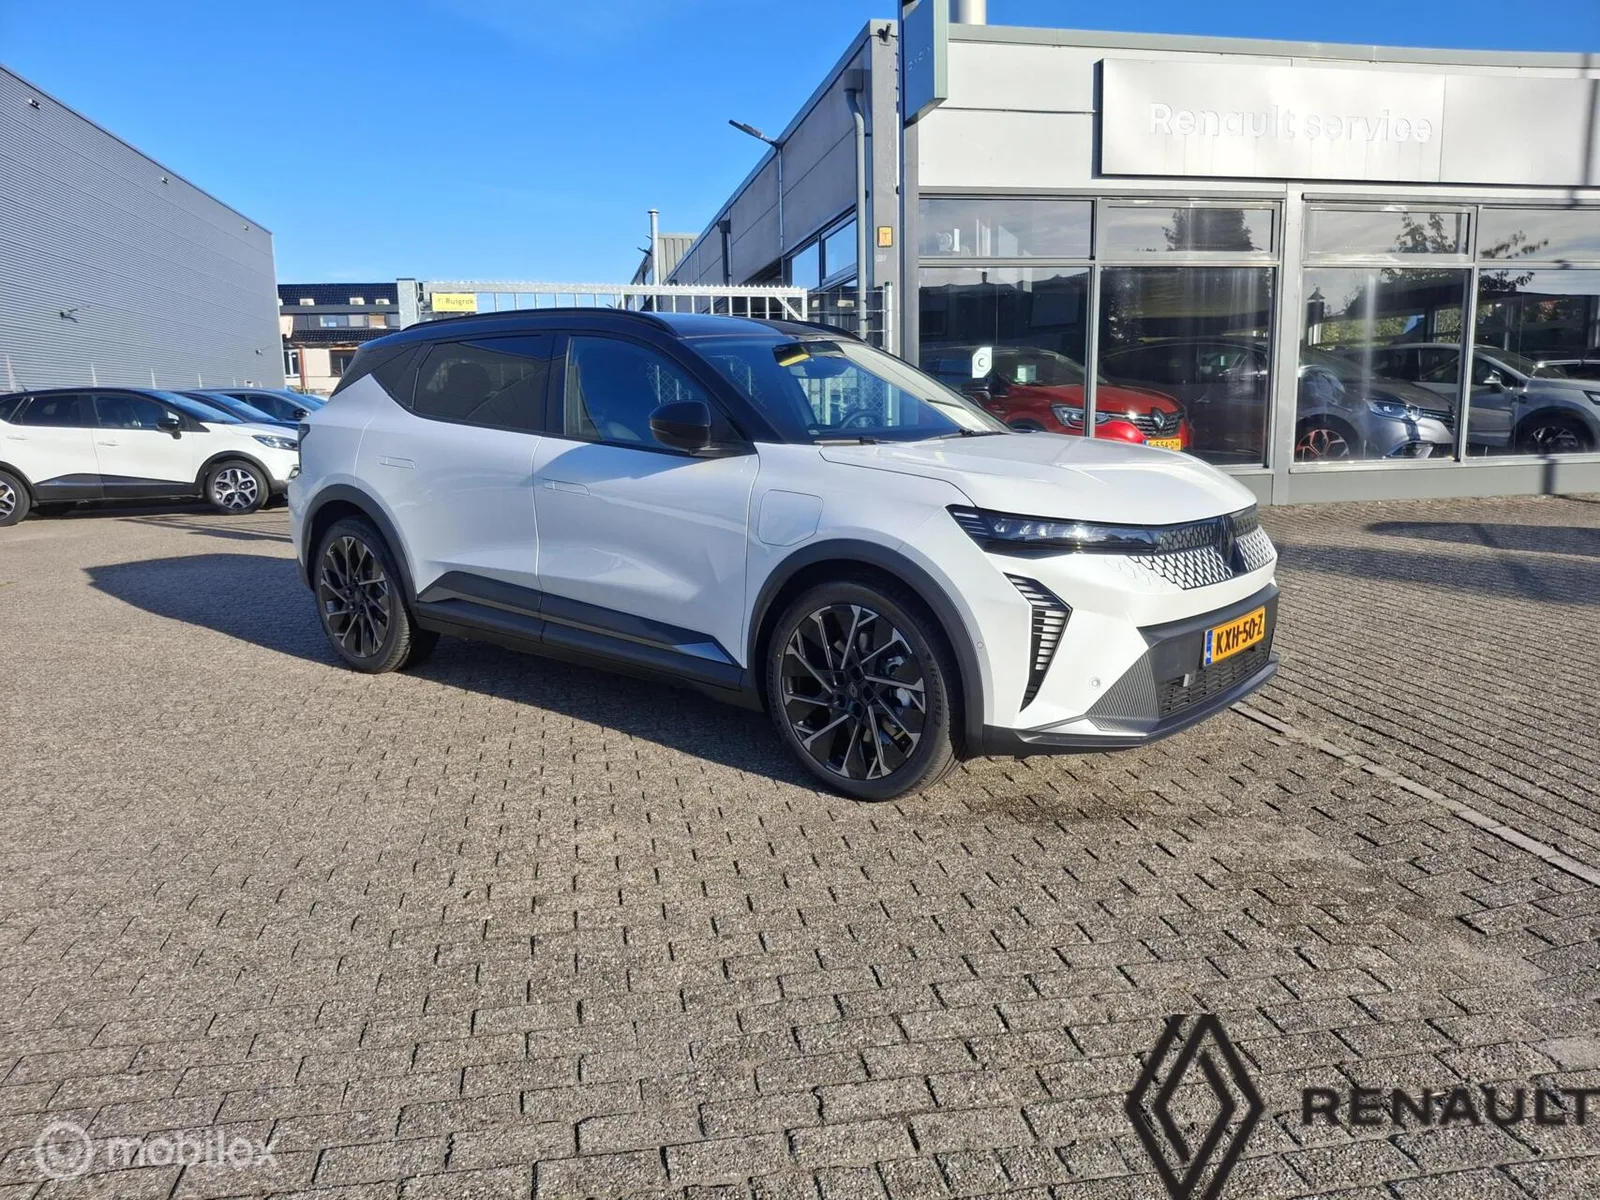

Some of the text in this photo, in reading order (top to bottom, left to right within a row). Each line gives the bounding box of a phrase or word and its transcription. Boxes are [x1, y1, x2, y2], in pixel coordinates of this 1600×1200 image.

[1149, 102, 1433, 144] Renault service
[445, 297, 474, 306] Ruigrok
[1215, 613, 1264, 656] KXH-50-Z
